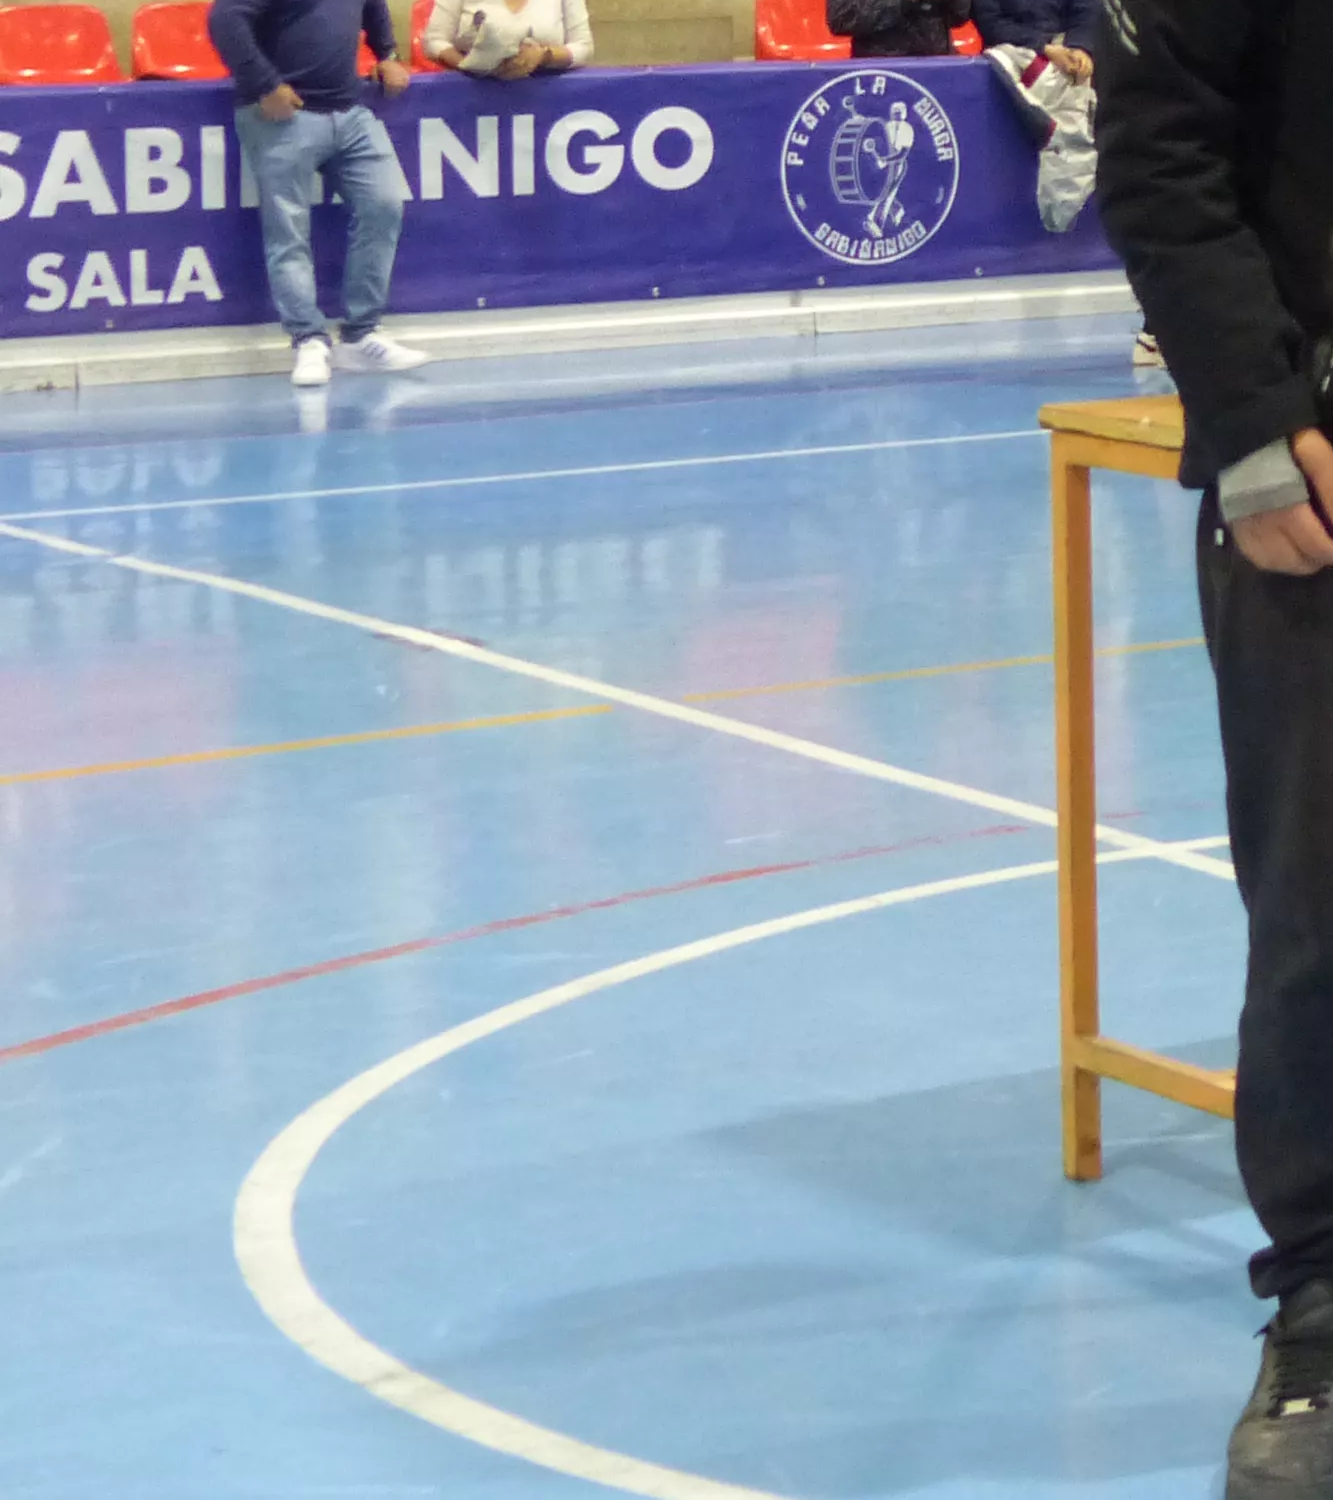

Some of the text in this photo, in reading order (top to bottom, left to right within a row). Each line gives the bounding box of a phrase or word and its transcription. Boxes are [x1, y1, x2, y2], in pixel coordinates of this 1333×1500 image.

[855, 76, 887, 96] LA
[913, 97, 954, 162] MURGA
[0, 106, 714, 222] ABINIGO
[24, 246, 225, 313] SALA
